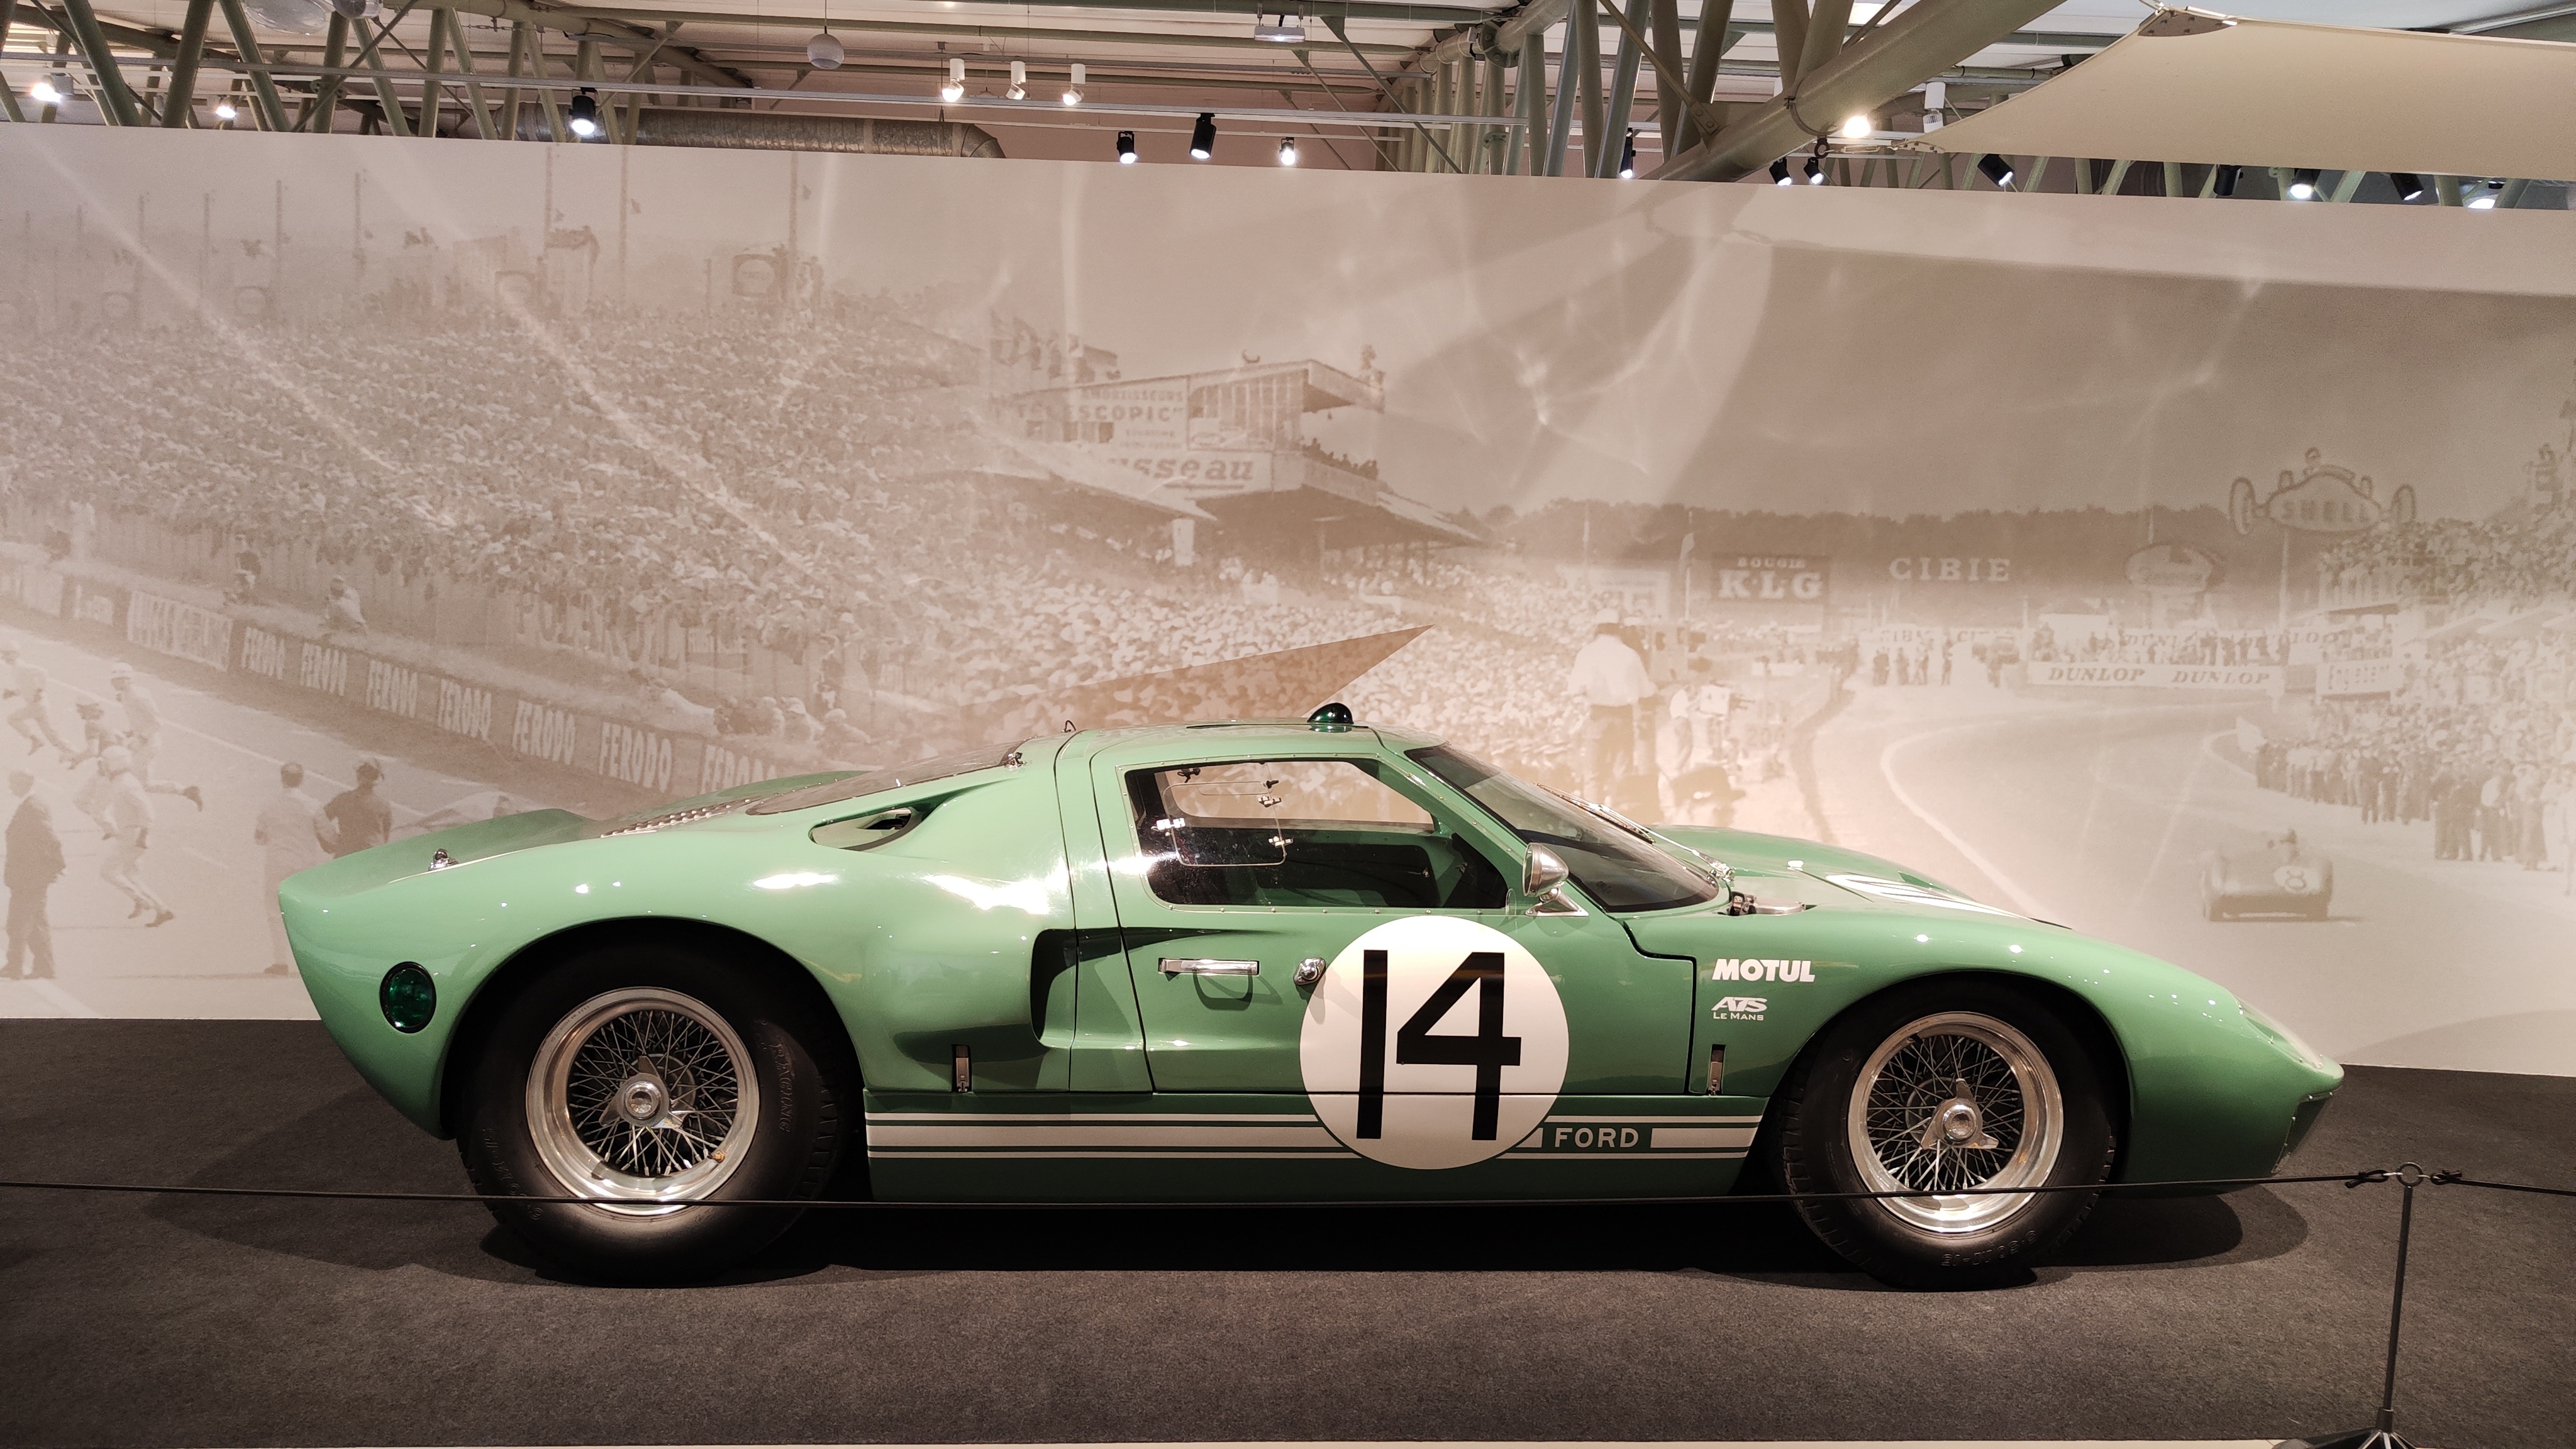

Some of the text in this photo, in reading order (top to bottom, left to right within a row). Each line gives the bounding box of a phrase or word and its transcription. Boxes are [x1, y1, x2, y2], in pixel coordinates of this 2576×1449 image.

[1108, 458, 1253, 480] sseau
[2280, 499, 2370, 523] SHELL
[1889, 557, 2011, 582] CIBIE
[2048, 667, 2270, 685] DUNLOP DUNLOP
[511, 699, 576, 766] FERODO
[599, 721, 672, 794] FERODO
[699, 743, 778, 795] FERO
[2285, 869, 2307, 891] 8
[1712, 958, 1816, 982] MOTUL
[1711, 996, 1768, 1013] ATS
[1356, 949, 1521, 1141] 14
[769, 1041, 794, 1133] RACING
[1555, 1127, 1639, 1149] FORD
